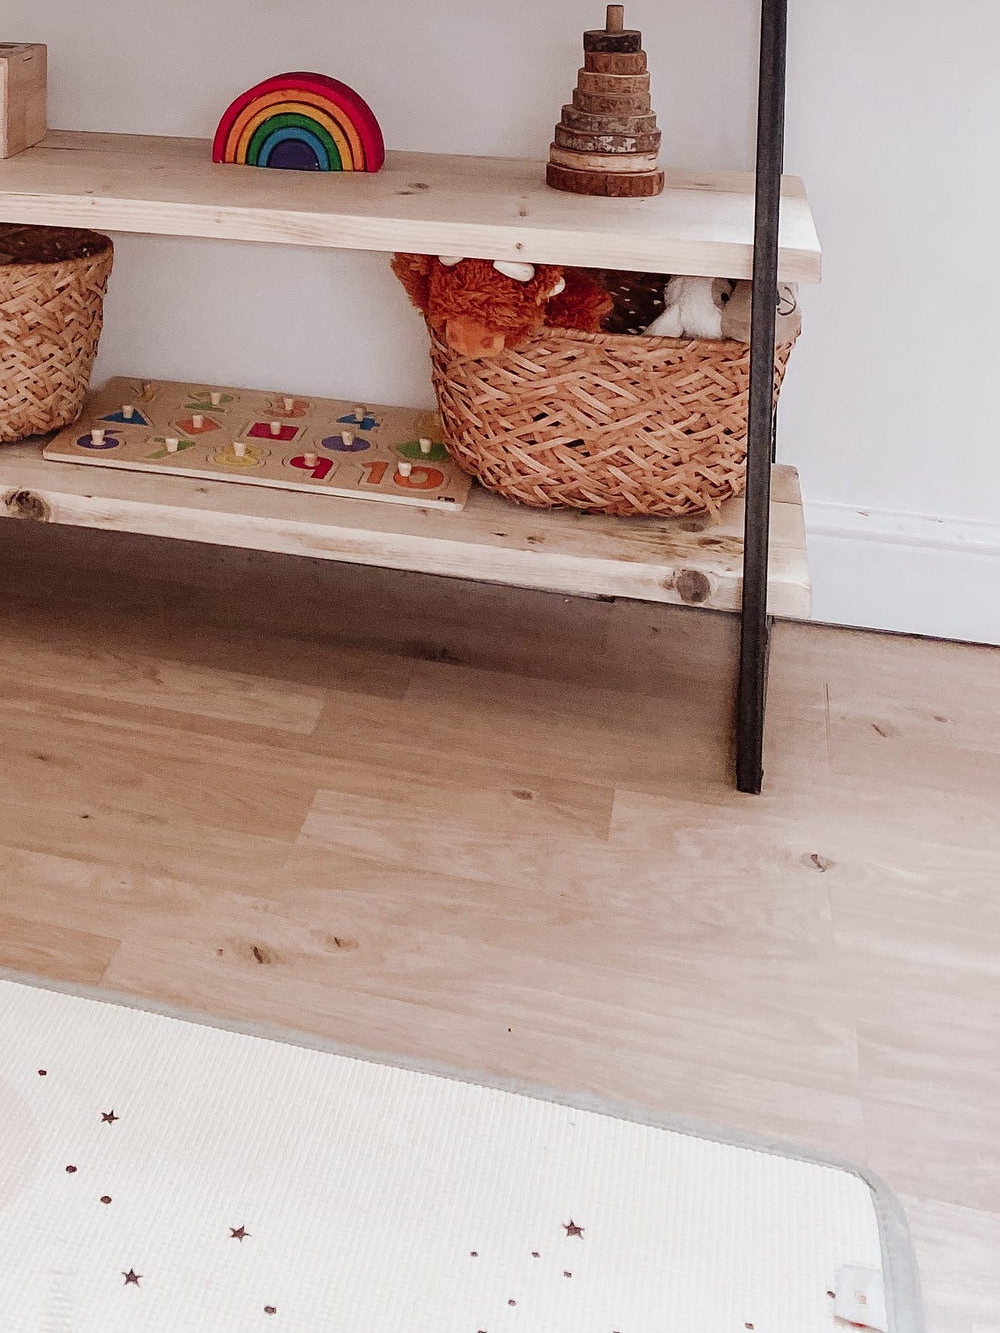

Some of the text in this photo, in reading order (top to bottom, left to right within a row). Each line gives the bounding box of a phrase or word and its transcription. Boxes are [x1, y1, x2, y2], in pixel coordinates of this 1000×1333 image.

[184, 391, 235, 413] 2
[263, 397, 310, 418] 3
[335, 406, 381, 431] 4
[76, 429, 444, 490] 6 7 8 9 10
